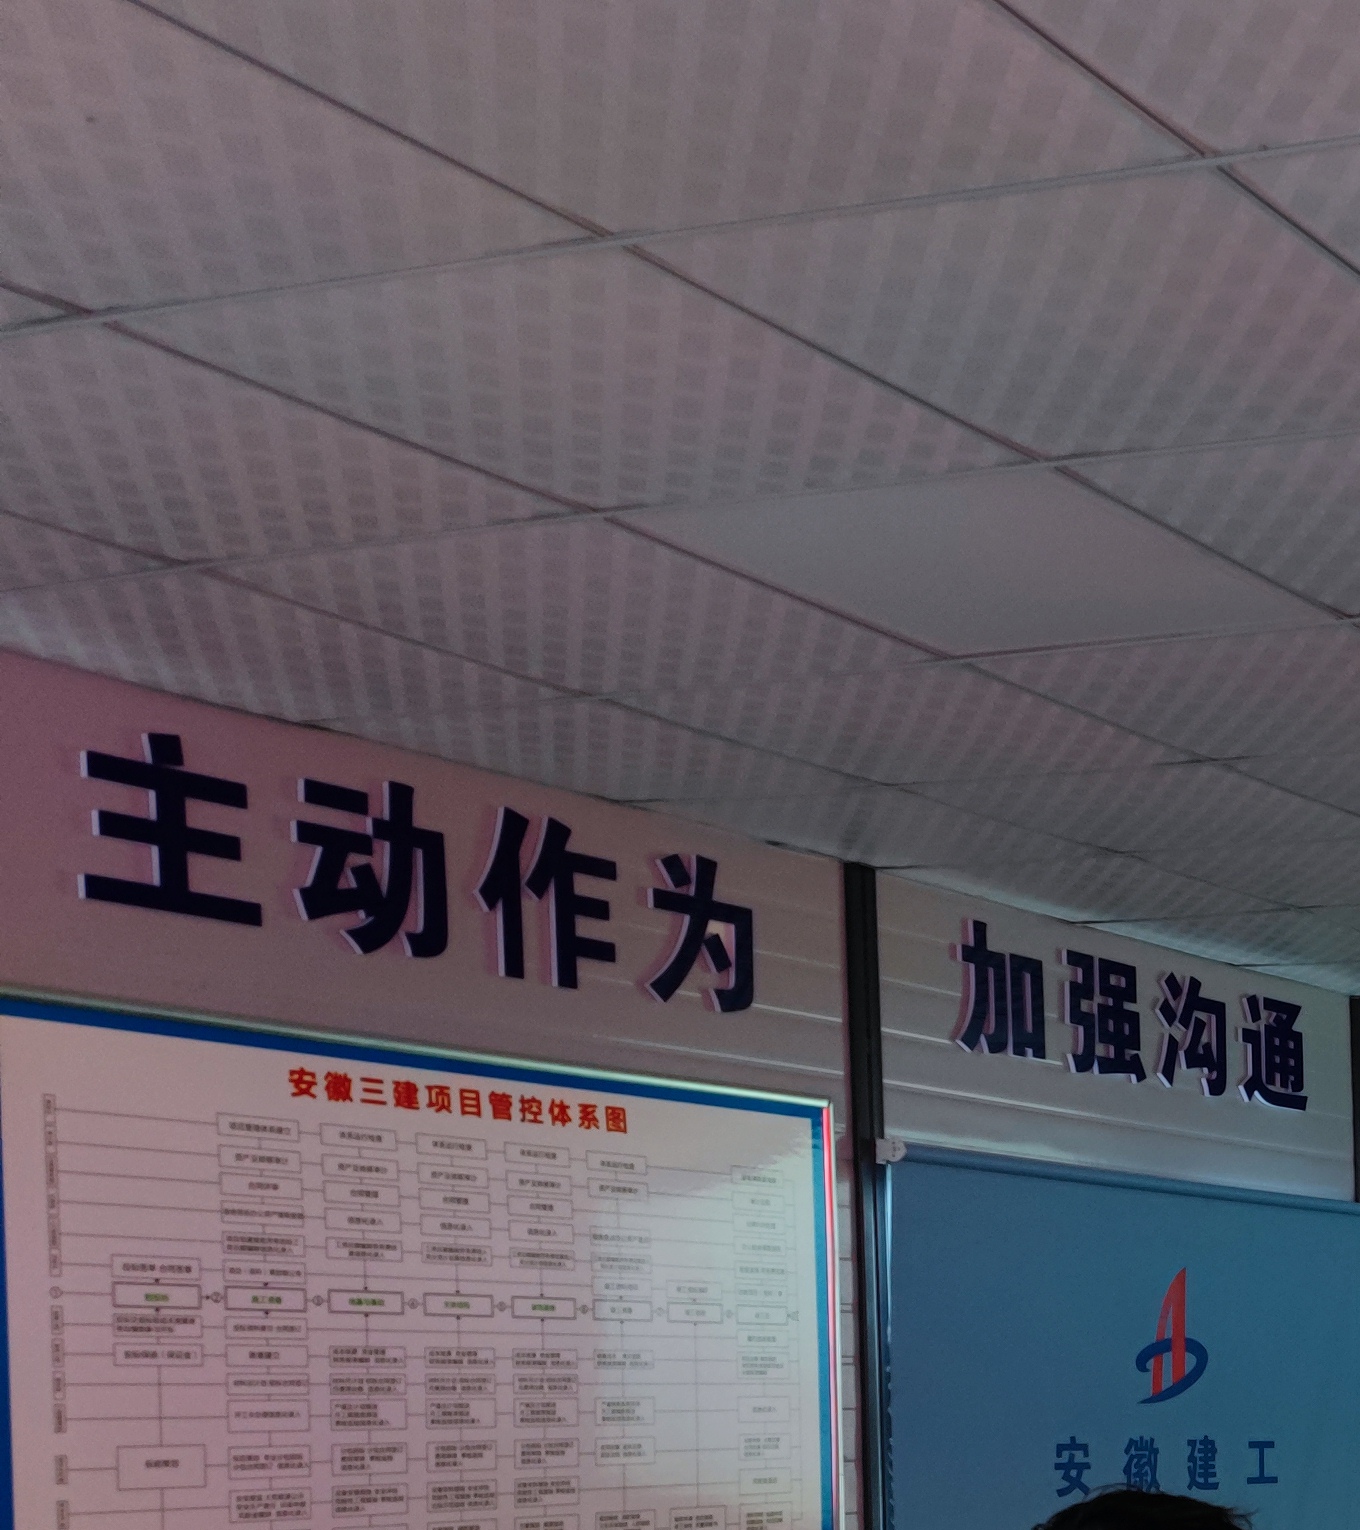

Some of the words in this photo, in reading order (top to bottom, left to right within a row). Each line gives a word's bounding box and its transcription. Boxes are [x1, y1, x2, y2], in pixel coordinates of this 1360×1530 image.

[78, 731, 757, 1014] 主动作为
[955, 918, 1309, 1111] 加强沟通
[288, 1066, 629, 1135] 安徽三建项目管控体系图
[1054, 1435, 1279, 1498] 安徽建工
